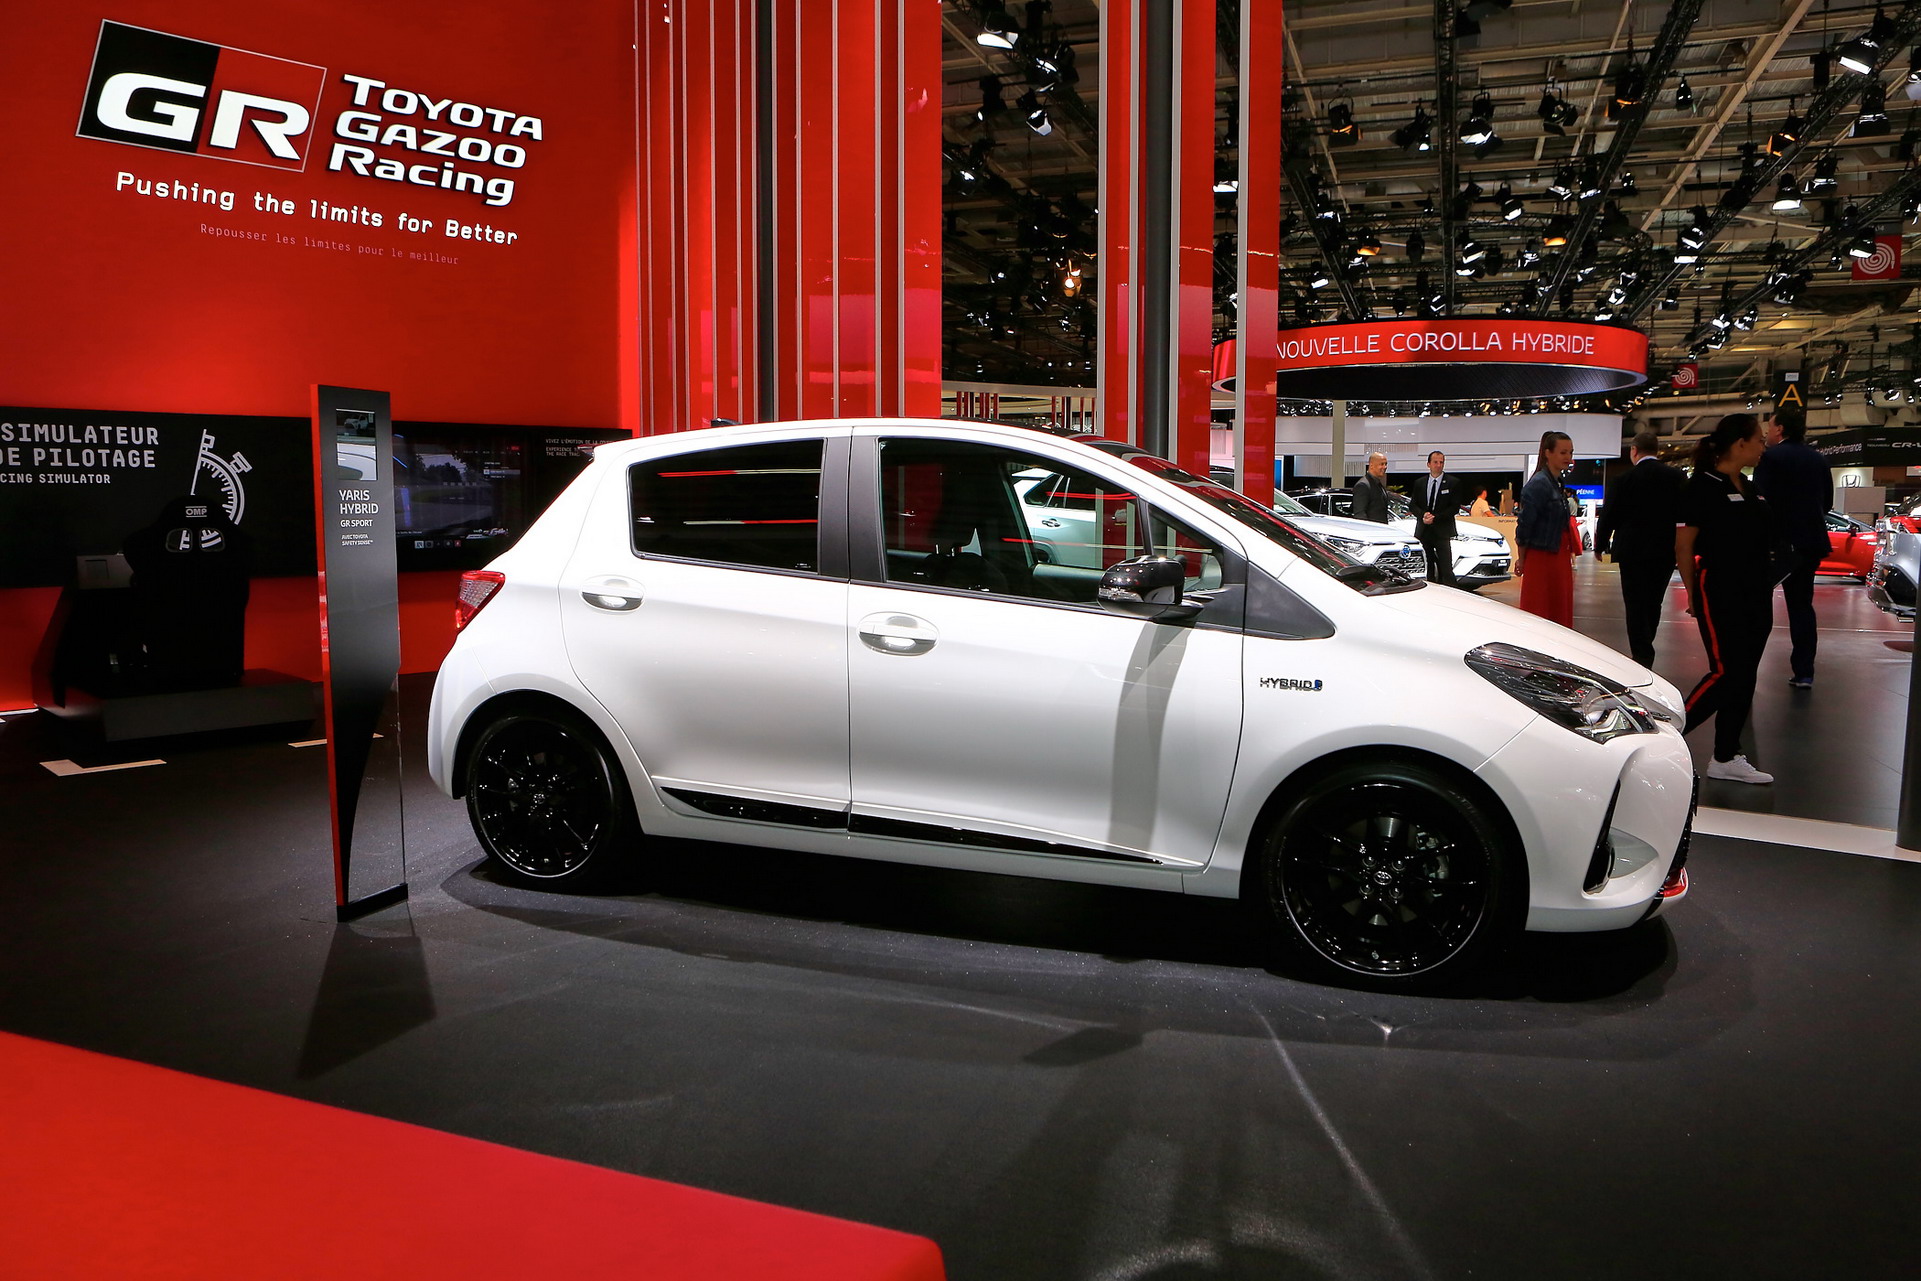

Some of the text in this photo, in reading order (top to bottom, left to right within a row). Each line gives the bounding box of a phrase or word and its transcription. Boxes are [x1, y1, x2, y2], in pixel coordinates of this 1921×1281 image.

[97, 72, 309, 160] GR
[343, 73, 543, 141] TOYOTA
[335, 110, 526, 168] GAZOO
[328, 142, 515, 207] Racing
[116, 171, 518, 245] Pushing the limits for Better
[200, 223, 459, 265] Repousser les limites pour le meilleur
[1276, 331, 1596, 359] NOUVELLE COROLLA HYBRIDE
[1778, 384, 1803, 407] A
[1, 422, 159, 446] SIMULATEUR
[33, 447, 156, 468] PILOTAGE
[39, 473, 111, 484] SIMULATOR
[339, 489, 370, 501] YARIS
[185, 508, 207, 516] OMP
[340, 503, 379, 515] HYBRID
[340, 519, 373, 528] GR SPORT
[1260, 677, 1312, 691] HYBRID
